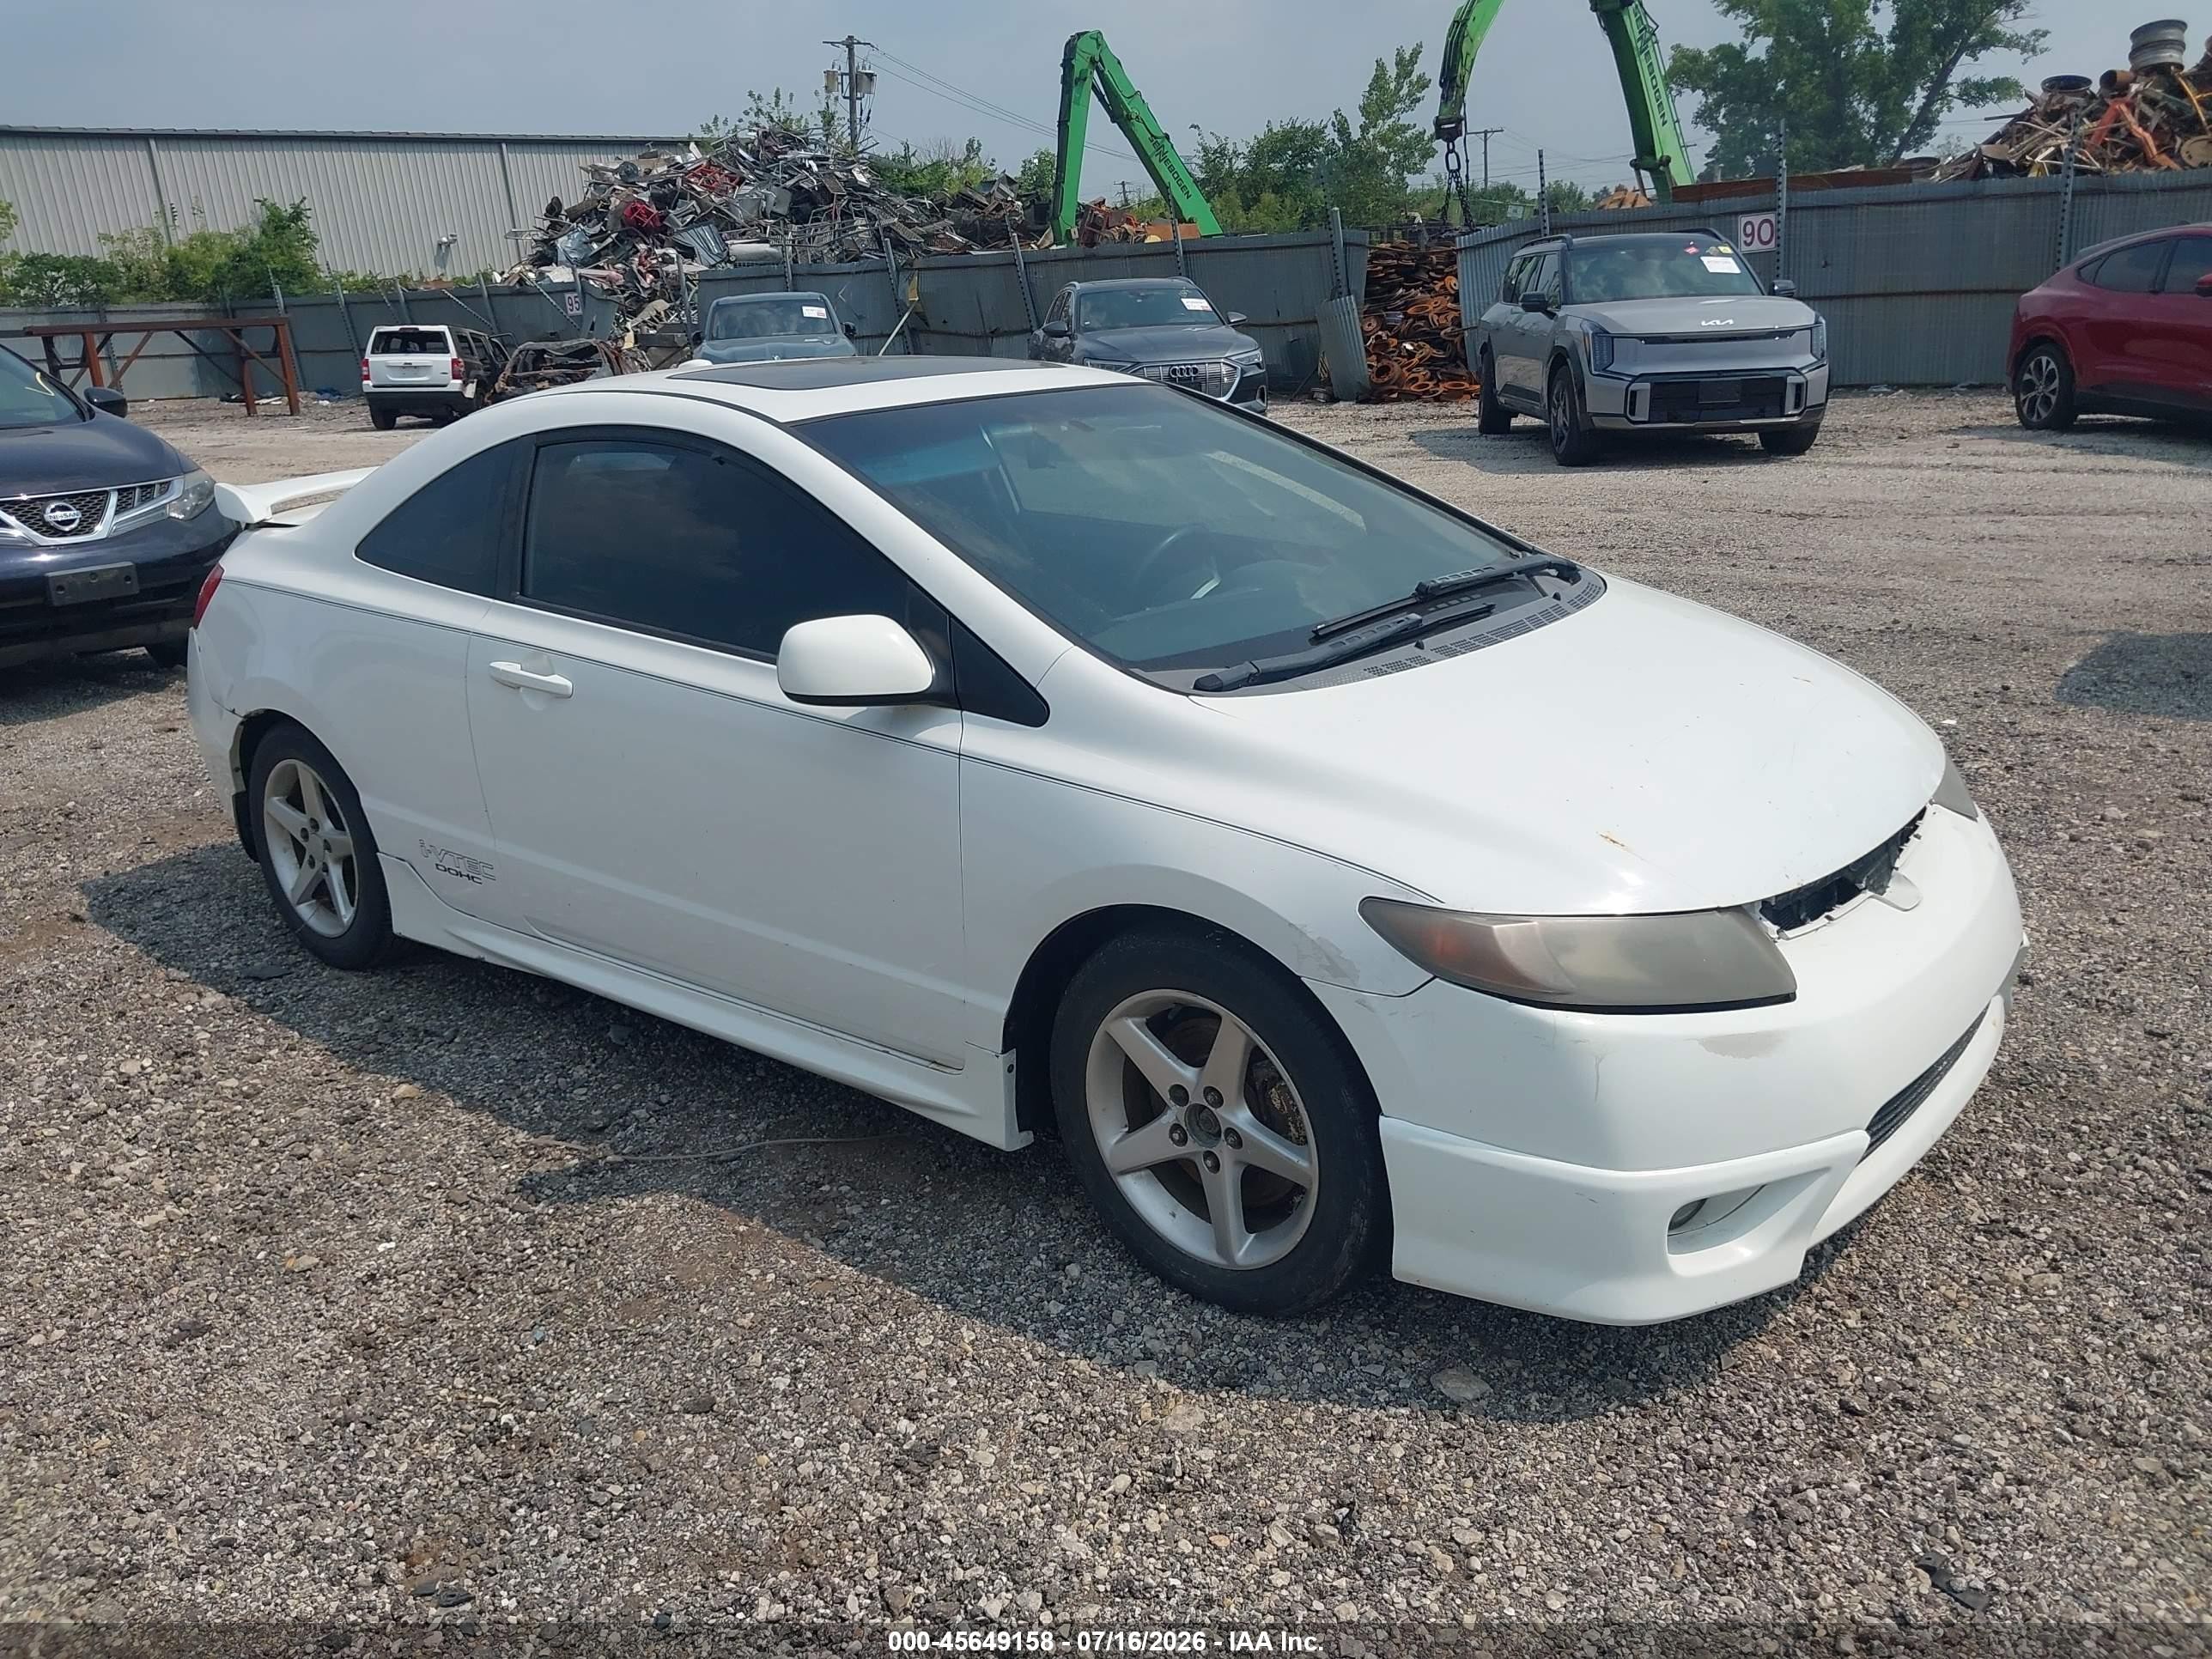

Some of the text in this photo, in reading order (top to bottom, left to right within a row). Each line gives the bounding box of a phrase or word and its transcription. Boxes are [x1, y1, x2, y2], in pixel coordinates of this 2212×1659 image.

[1148, 137, 1192, 200] SENNEBOGEN
[1743, 218, 1774, 246] 90
[567, 295, 580, 312] 95
[434, 863, 483, 885] DOHC
